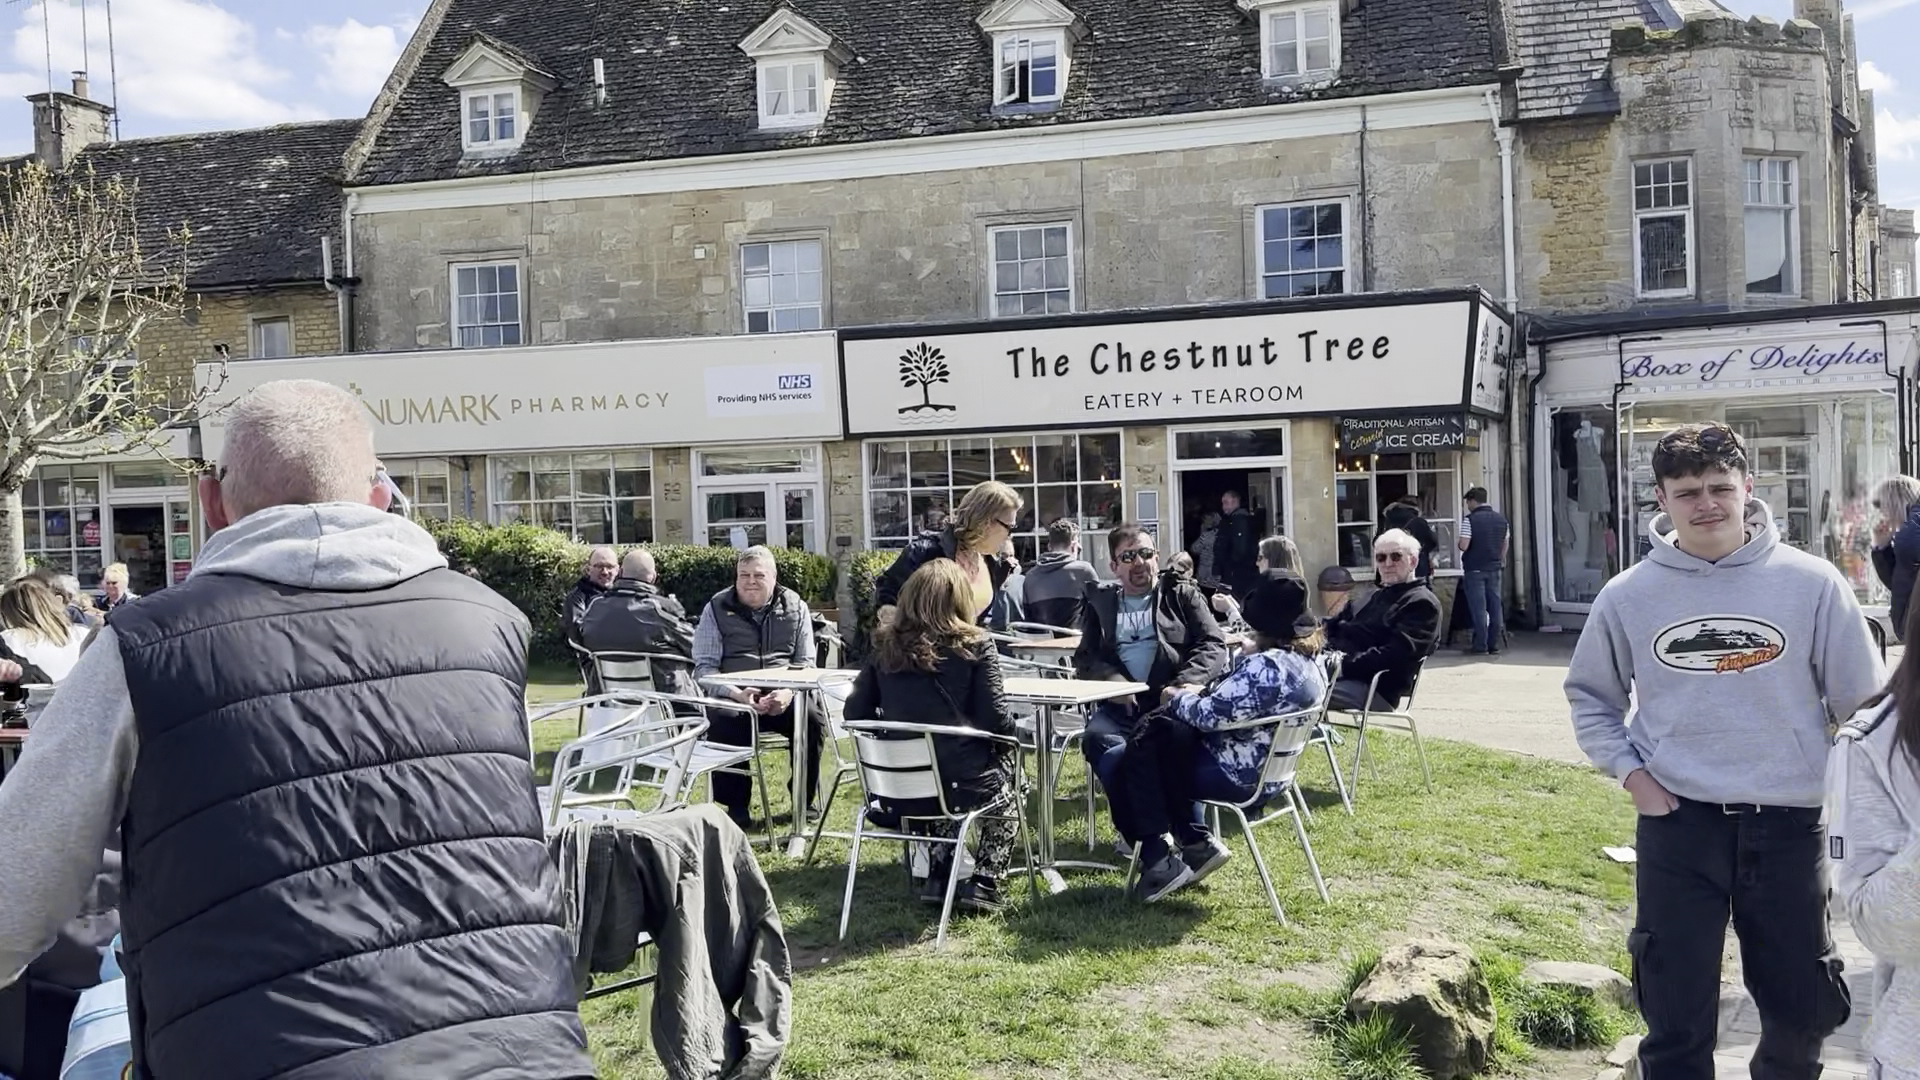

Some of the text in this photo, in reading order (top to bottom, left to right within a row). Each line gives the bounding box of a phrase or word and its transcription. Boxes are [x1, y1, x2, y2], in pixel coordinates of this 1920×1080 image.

[1006, 329, 1391, 379] The Chestnut Tree
[1622, 341, 1885, 382] Box of Delights
[780, 375, 811, 389] NHS
[717, 391, 812, 404] Providing NHS services
[1084, 391, 1164, 411] EATERY
[1191, 385, 1304, 405] TEAROOM
[362, 392, 669, 426] NUMARK PHARMACY
[1343, 417, 1445, 430] TRADITIONAL ARTISAN
[1385, 434, 1408, 448] ICE
[1412, 432, 1464, 447] CREAM
